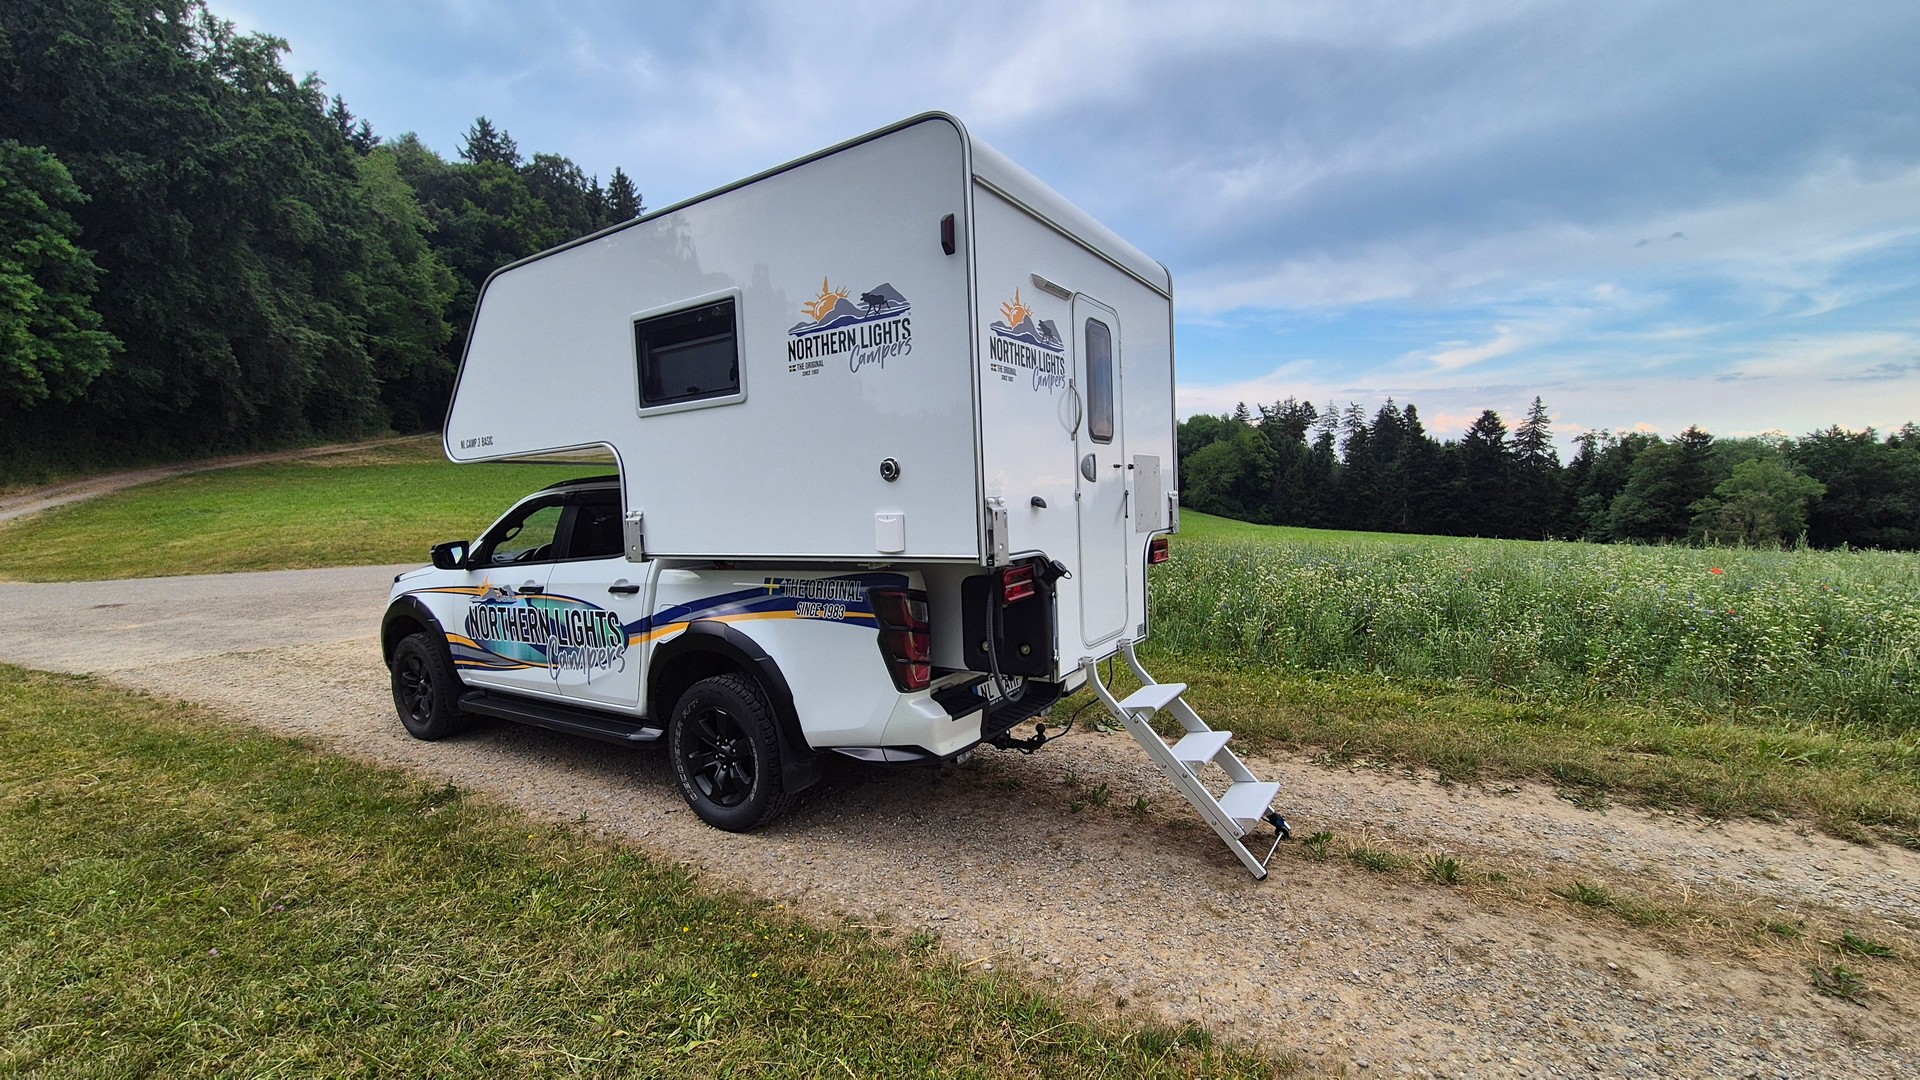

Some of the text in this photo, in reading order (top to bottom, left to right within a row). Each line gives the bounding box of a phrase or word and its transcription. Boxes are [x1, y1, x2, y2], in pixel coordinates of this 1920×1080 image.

[787, 318, 912, 362] NORTHERN LIGHTS
[849, 336, 913, 374] Campers
[989, 335, 1065, 376] NORTHERN LIGHTS
[1032, 365, 1066, 396] Campers
[481, 436, 493, 446] BASIC
[783, 577, 864, 602] THE ORIGINAL
[469, 604, 622, 649] NORTHERN LIGHTS
[795, 602, 846, 620] SINCE 1983
[546, 636, 626, 686] Campers
